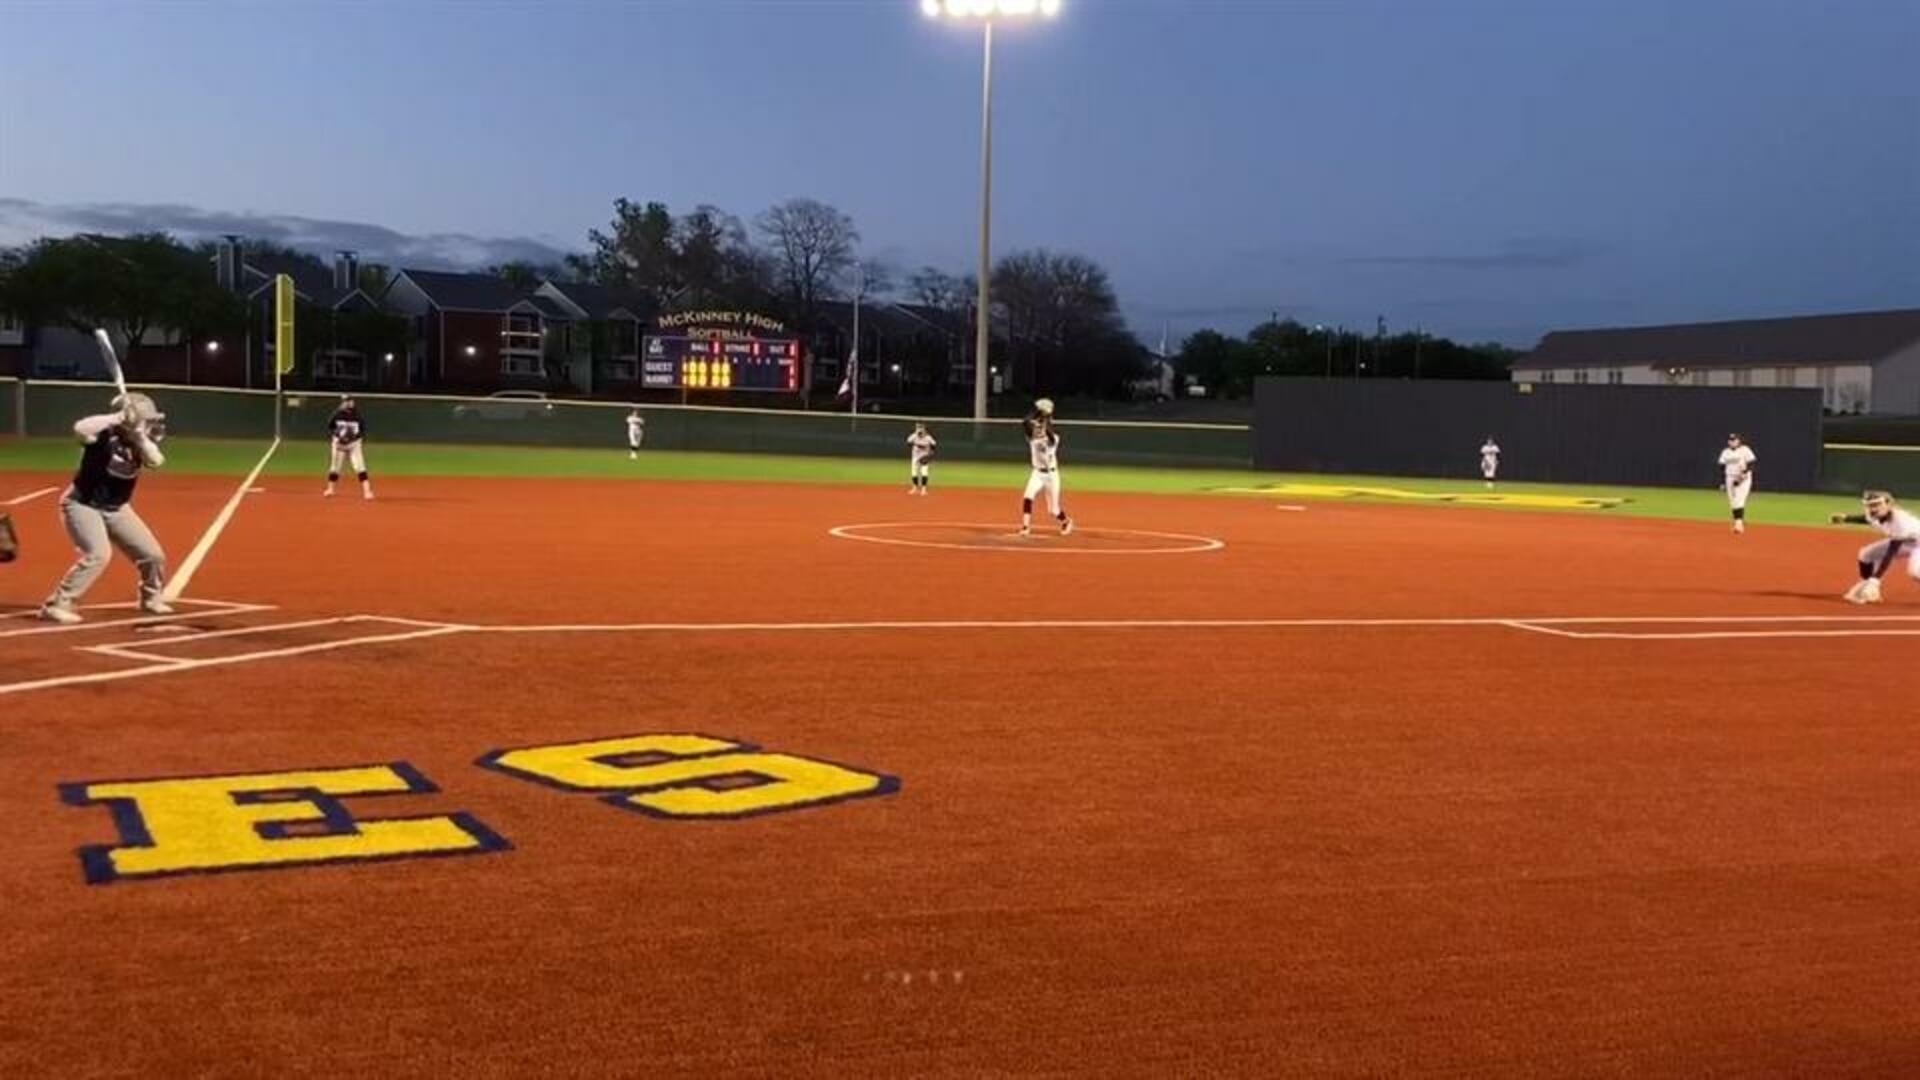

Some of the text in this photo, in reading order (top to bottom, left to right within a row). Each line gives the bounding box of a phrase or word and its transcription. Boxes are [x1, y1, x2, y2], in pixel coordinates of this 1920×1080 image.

[744, 312, 784, 332] HIGH
[687, 327, 755, 339] SOFTBALL
[691, 342, 709, 352] BALL
[645, 361, 673, 372] GUEST
